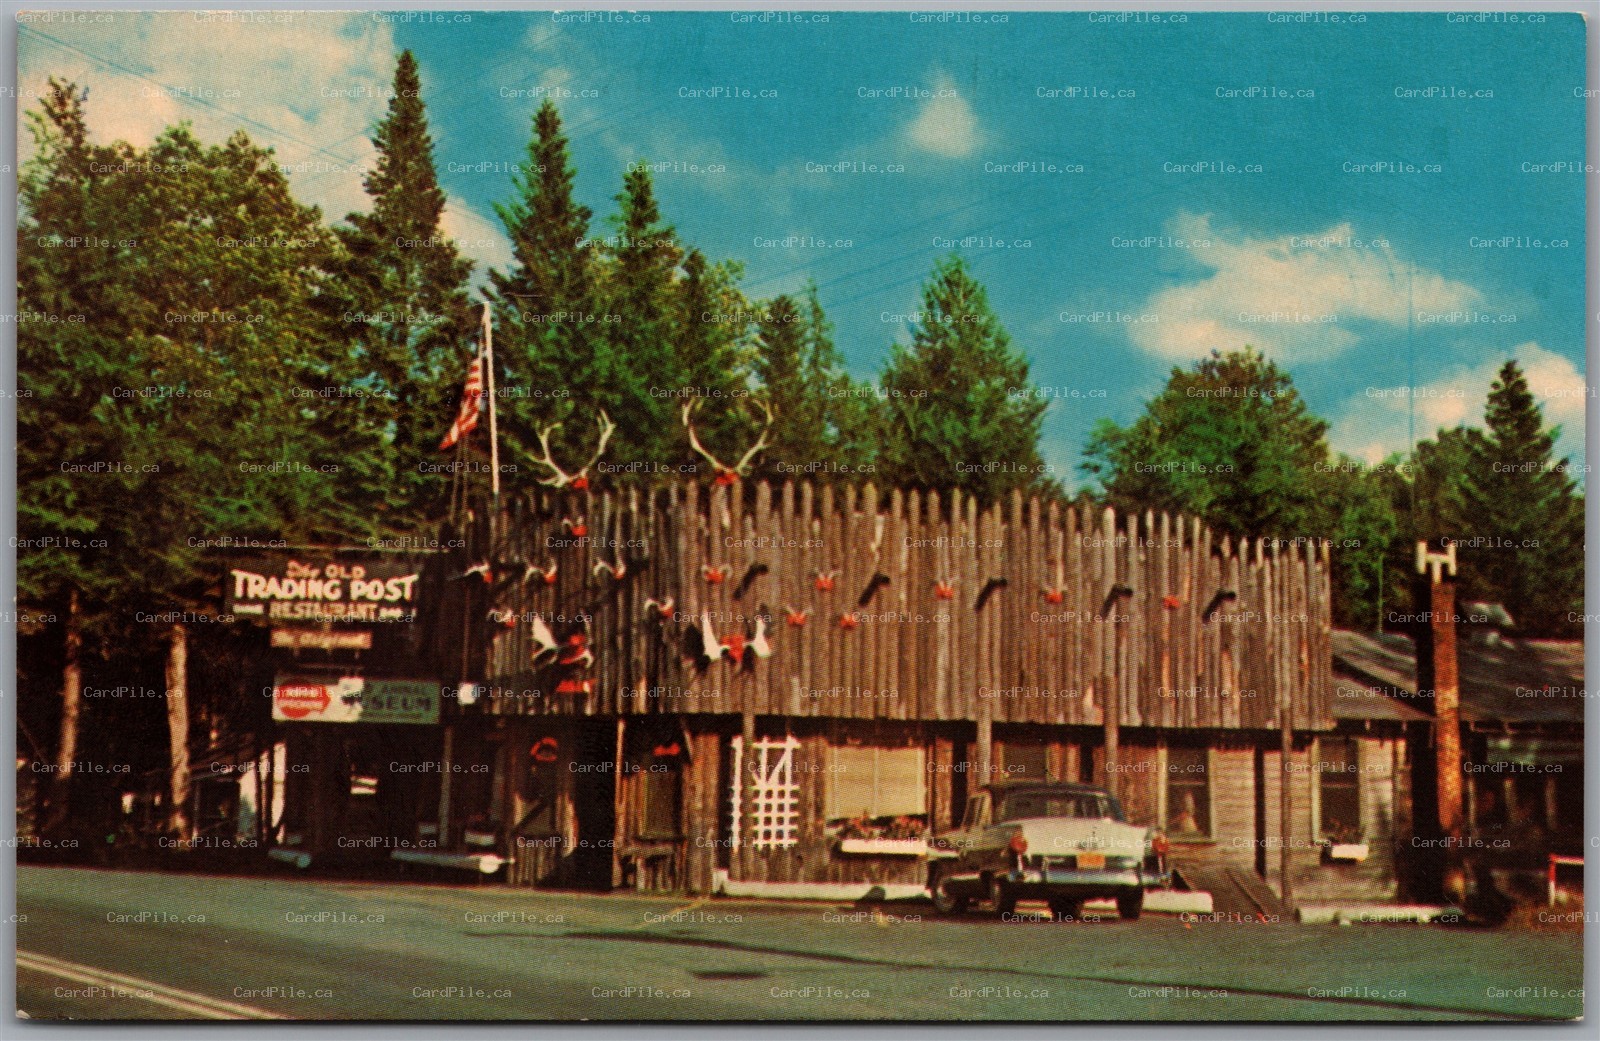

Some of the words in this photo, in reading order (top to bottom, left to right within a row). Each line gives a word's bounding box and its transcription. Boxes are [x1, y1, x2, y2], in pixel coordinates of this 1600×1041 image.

[325, 564, 367, 579] OLD
[230, 568, 342, 601] TRADING
[349, 573, 420, 602] POST
[268, 601, 378, 620] RESTAURANT
